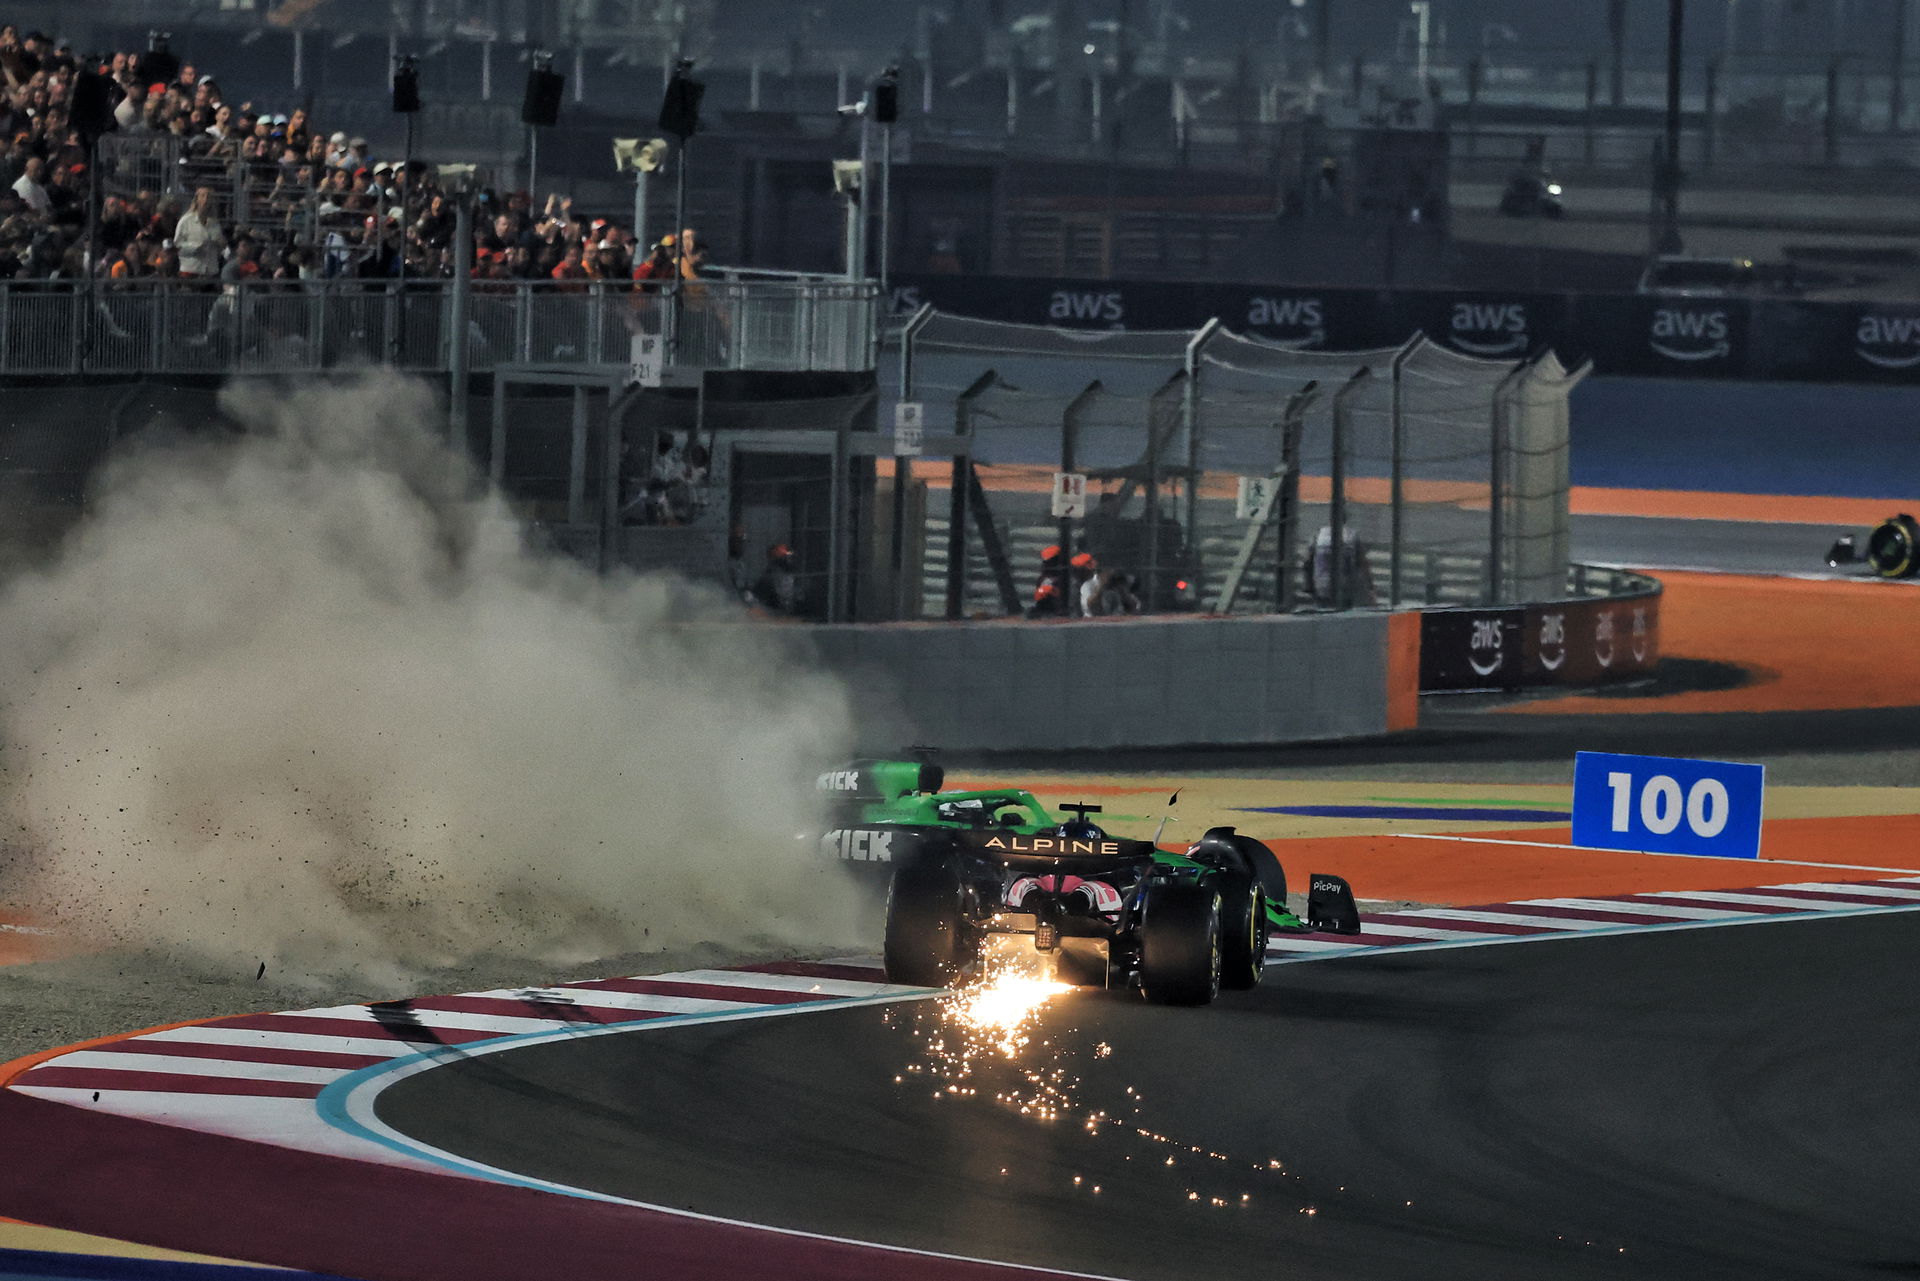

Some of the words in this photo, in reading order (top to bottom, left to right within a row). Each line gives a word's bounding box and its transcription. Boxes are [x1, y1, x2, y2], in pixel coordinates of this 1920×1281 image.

[1049, 289, 1124, 321] aws
[1249, 297, 1322, 327] aws
[1452, 302, 1526, 332] aws
[1653, 309, 1729, 340] aws
[1471, 618, 1503, 650] aws
[816, 771, 859, 791] KICK
[1608, 772, 1729, 838] 100
[820, 829, 893, 862] KICK
[984, 836, 1119, 855] ALPINE
[1313, 880, 1342, 894] PicPay
